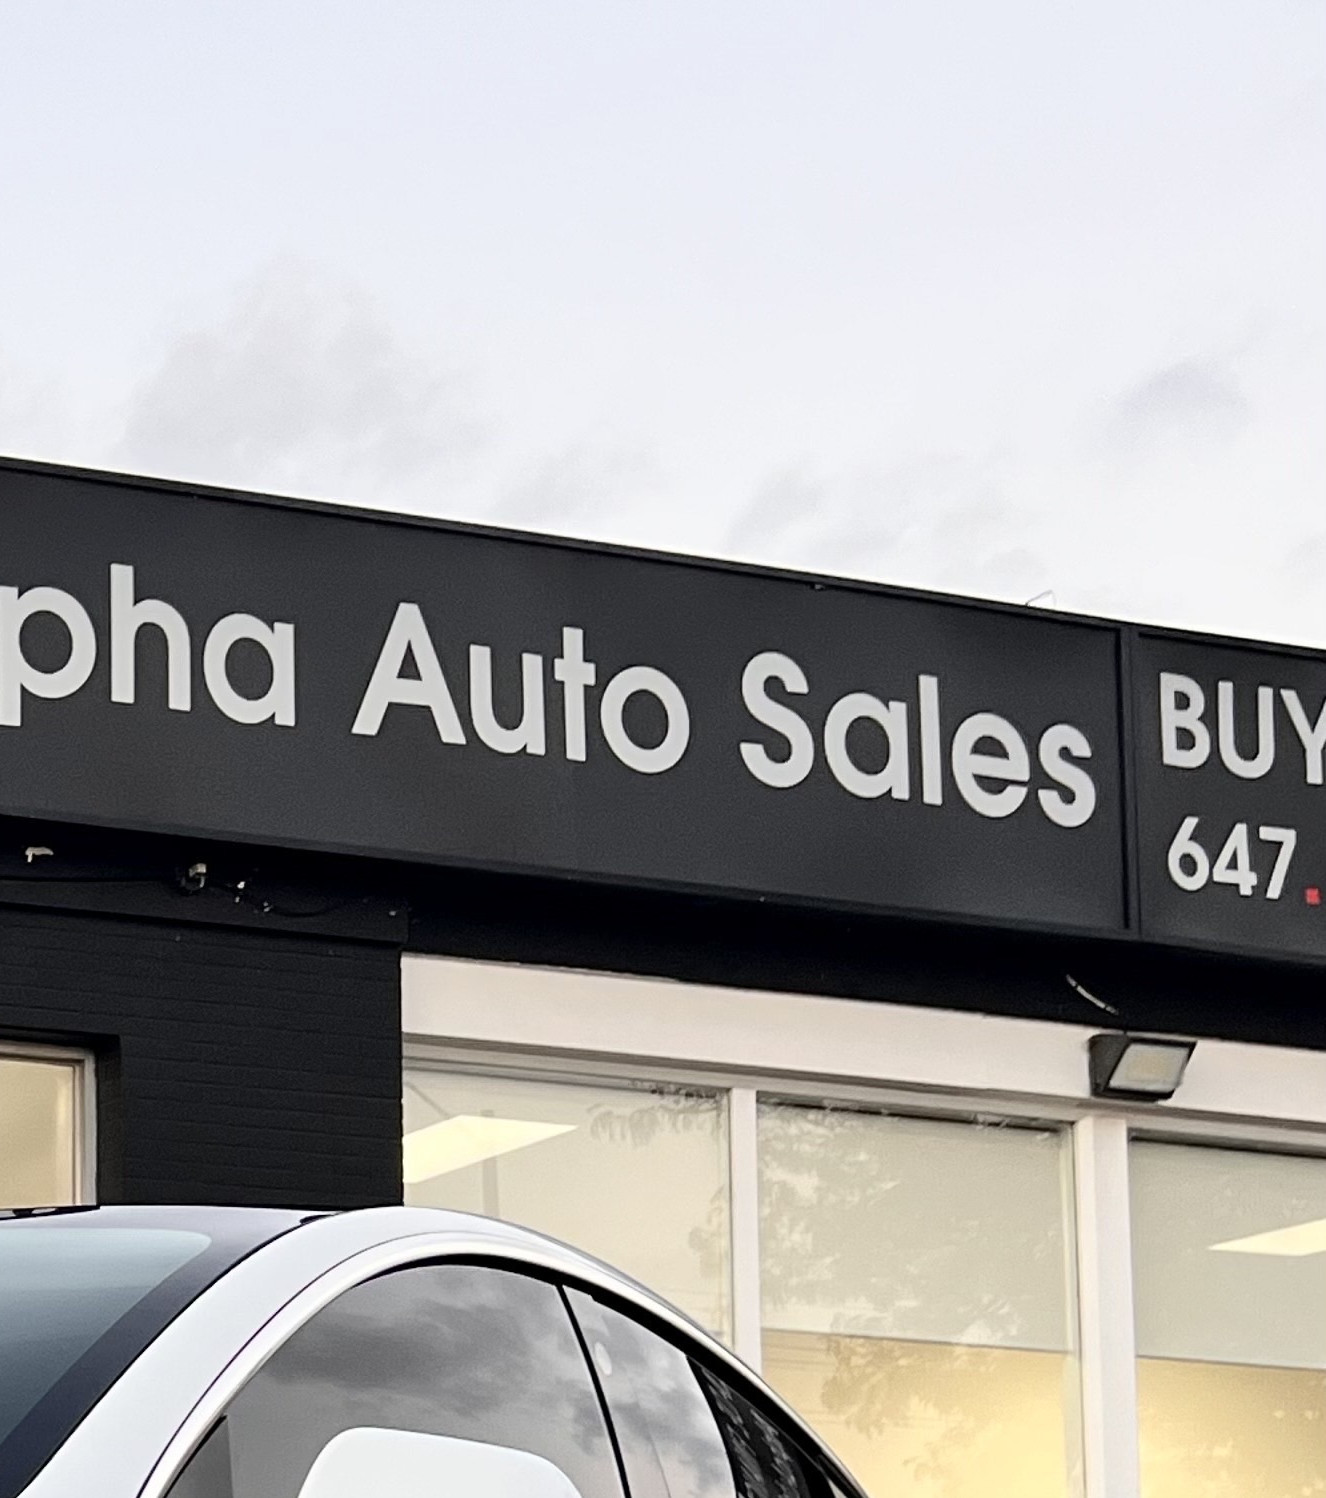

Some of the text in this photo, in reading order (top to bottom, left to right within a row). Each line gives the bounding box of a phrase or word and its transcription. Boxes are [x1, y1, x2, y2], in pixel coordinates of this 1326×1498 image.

[351, 601, 691, 775] Auto
[738, 650, 1098, 829] Sales
[1159, 671, 1326, 785] BUY
